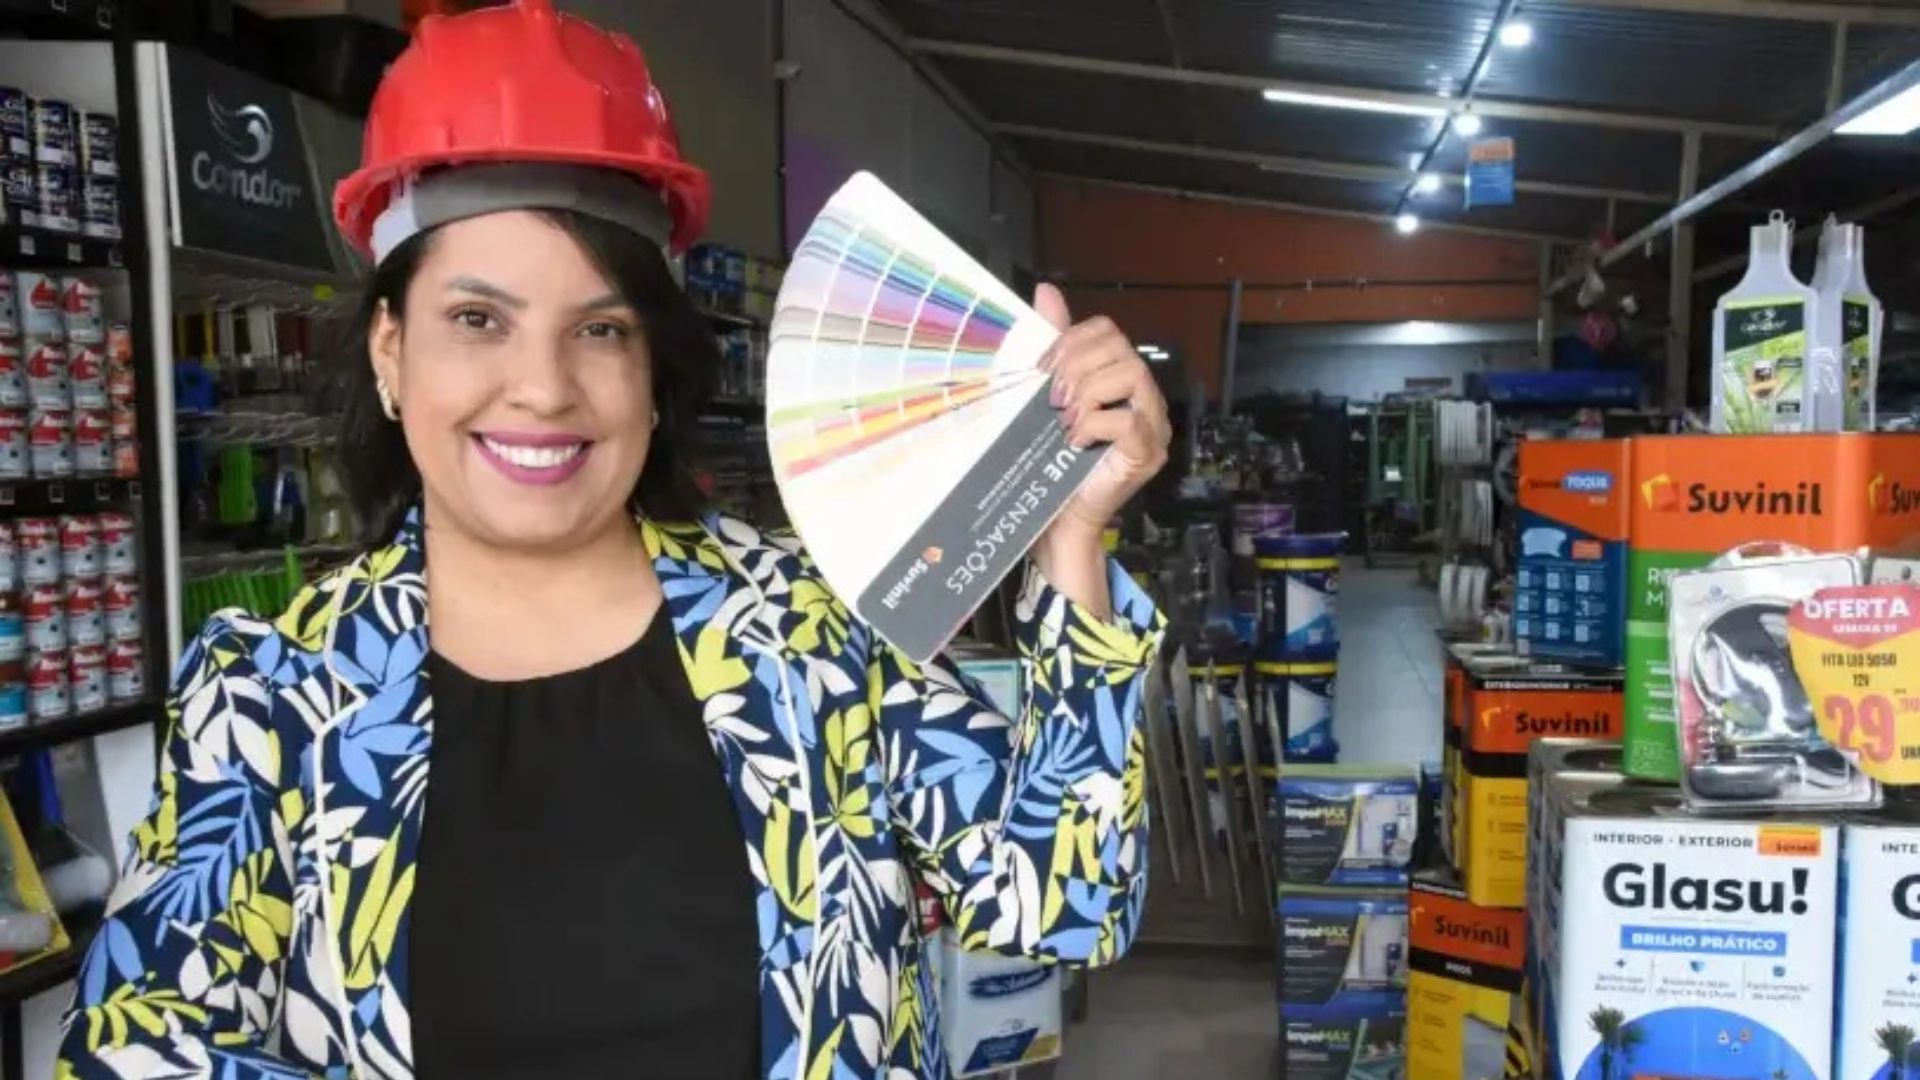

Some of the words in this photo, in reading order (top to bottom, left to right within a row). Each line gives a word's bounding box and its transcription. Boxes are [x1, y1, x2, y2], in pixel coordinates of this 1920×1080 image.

[192, 150, 302, 209] Condor
[1688, 482, 1822, 516] Suvinil
[945, 480, 1048, 596] SENSAÇÕES
[881, 557, 929, 610] Suvinil
[1803, 598, 1911, 620] OFERTA
[1515, 711, 1610, 735] Suvinil
[1594, 833, 1664, 846] INTERIOR
[1678, 836, 1753, 849] EXTERIOR
[1603, 862, 1809, 915] Glasu!
[1435, 914, 1511, 949] Suvinil
[1631, 932, 1697, 946] BRILHO
[1700, 932, 1778, 951] PRÁTICO
